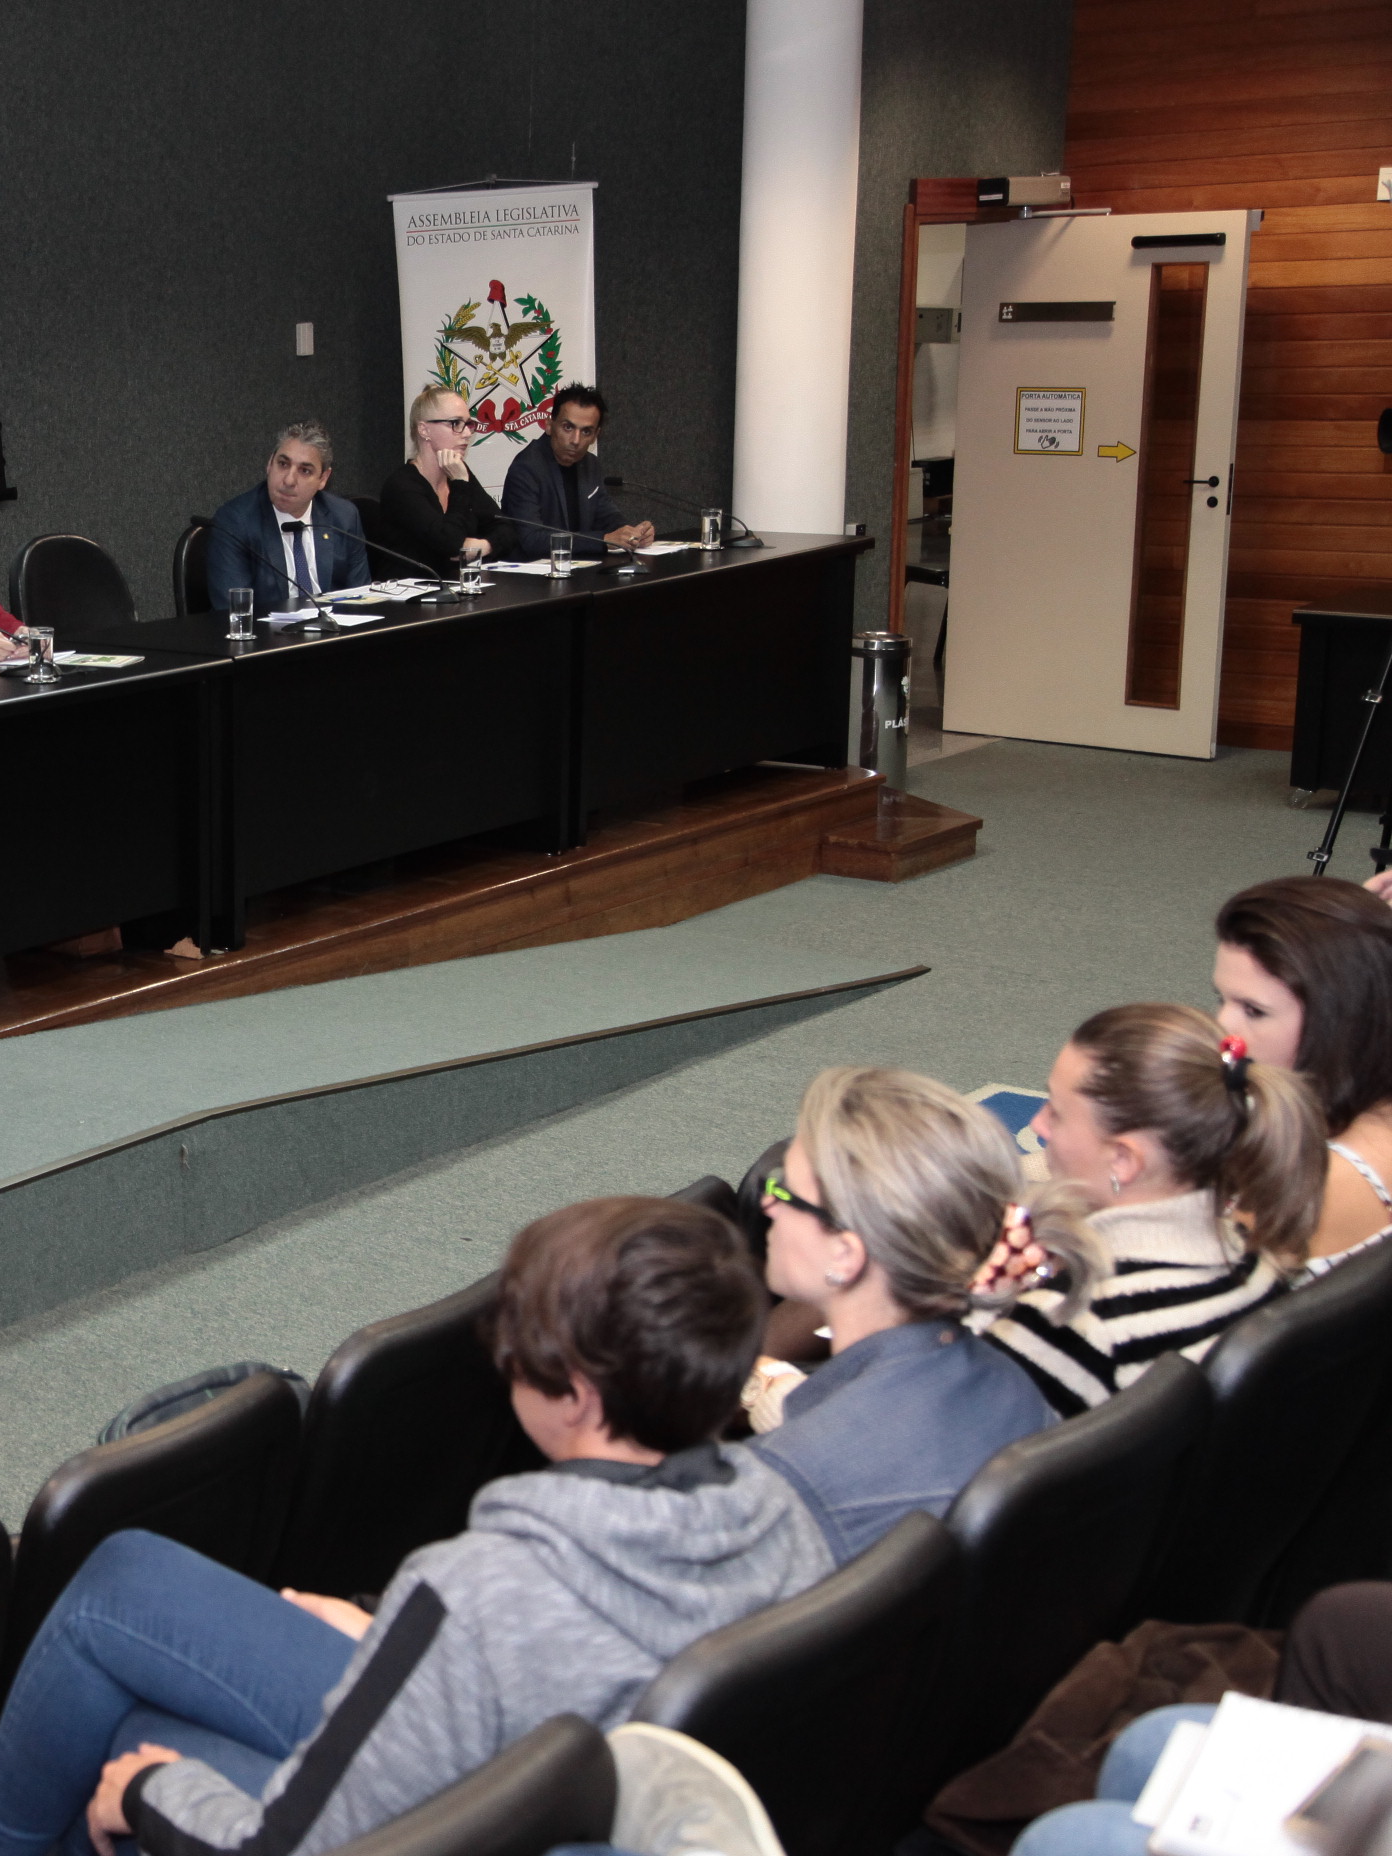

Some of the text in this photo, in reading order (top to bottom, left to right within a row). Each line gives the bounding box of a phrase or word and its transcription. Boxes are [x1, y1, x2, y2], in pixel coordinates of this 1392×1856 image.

[408, 204, 579, 228] ASSEMBLEIA LEGISLATIVA
[407, 224, 579, 246] DO ESTADO DE SANTA CATARINA
[1042, 392, 1080, 400] AUTOMÁTICA
[476, 424, 488, 432] DE
[520, 411, 552, 426] CATARIN
